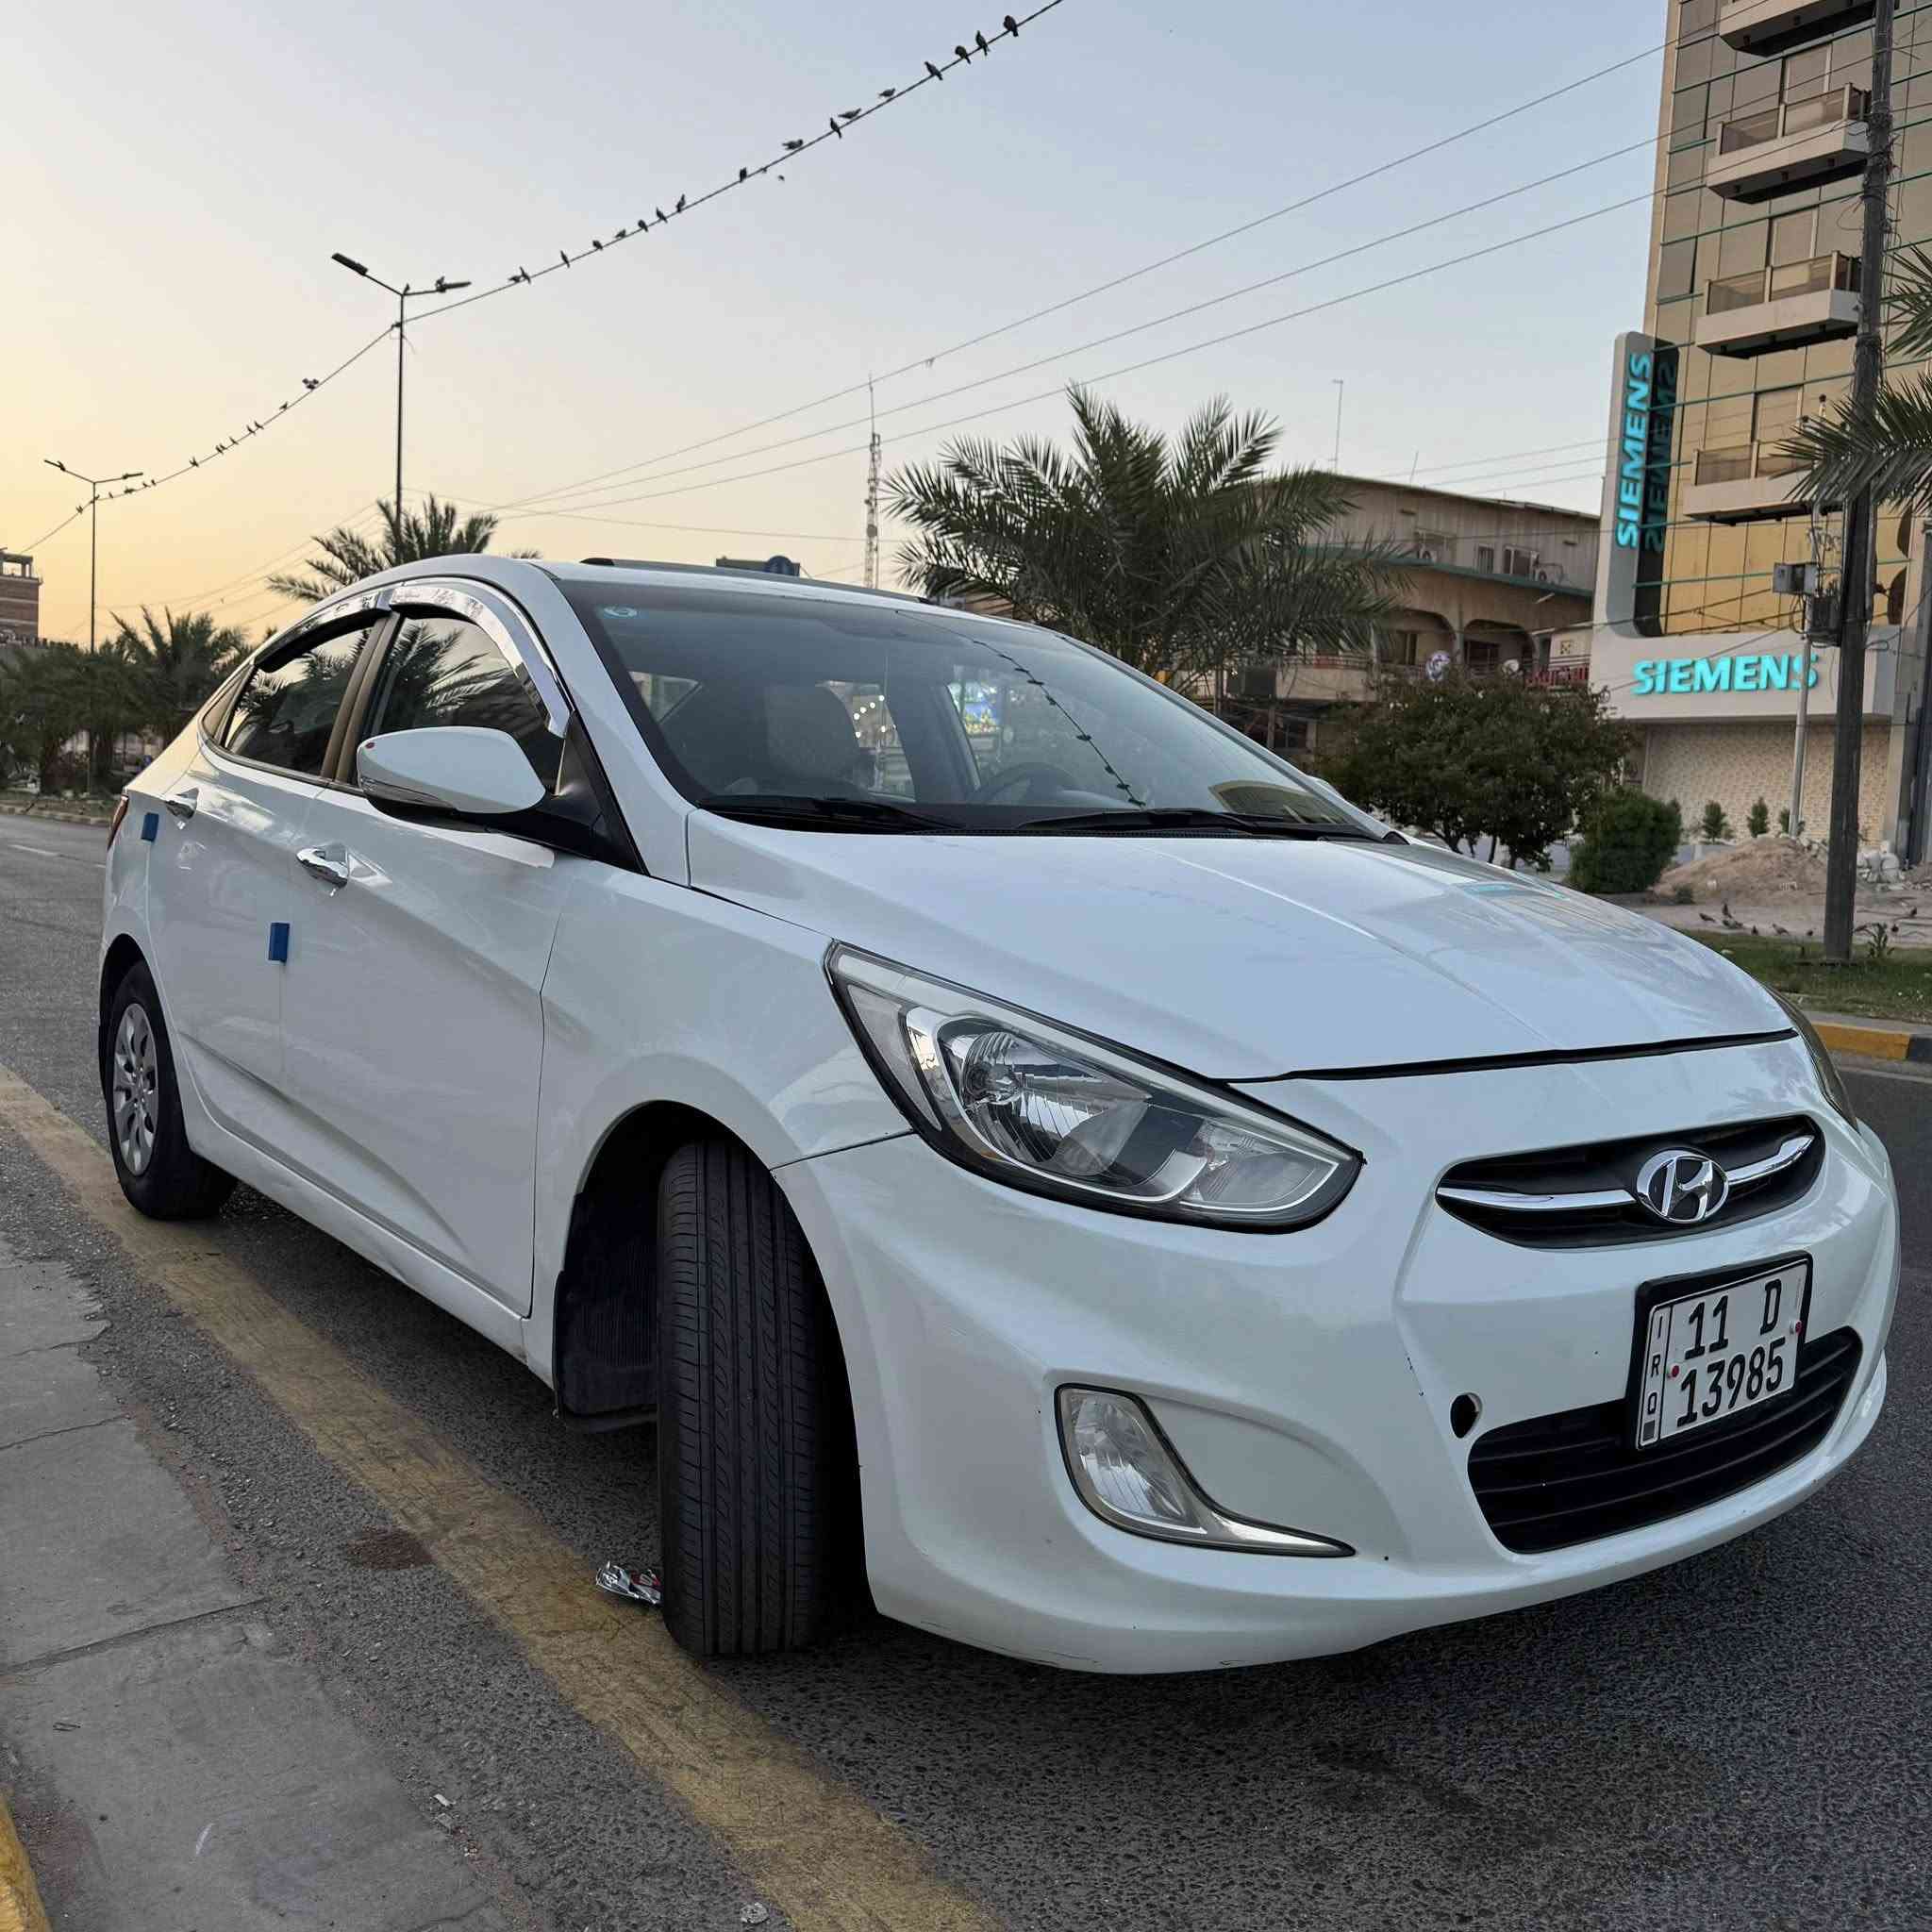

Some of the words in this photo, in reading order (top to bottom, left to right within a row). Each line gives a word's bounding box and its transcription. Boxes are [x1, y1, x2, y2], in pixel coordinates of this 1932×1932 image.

[1616, 353, 1651, 548] SIEMENS
[1631, 653, 1819, 694] SIEMENS
[1685, 1295, 1729, 1360] 11
[1759, 1278, 1782, 1336] D
[1676, 1336, 1786, 1427] 13985
